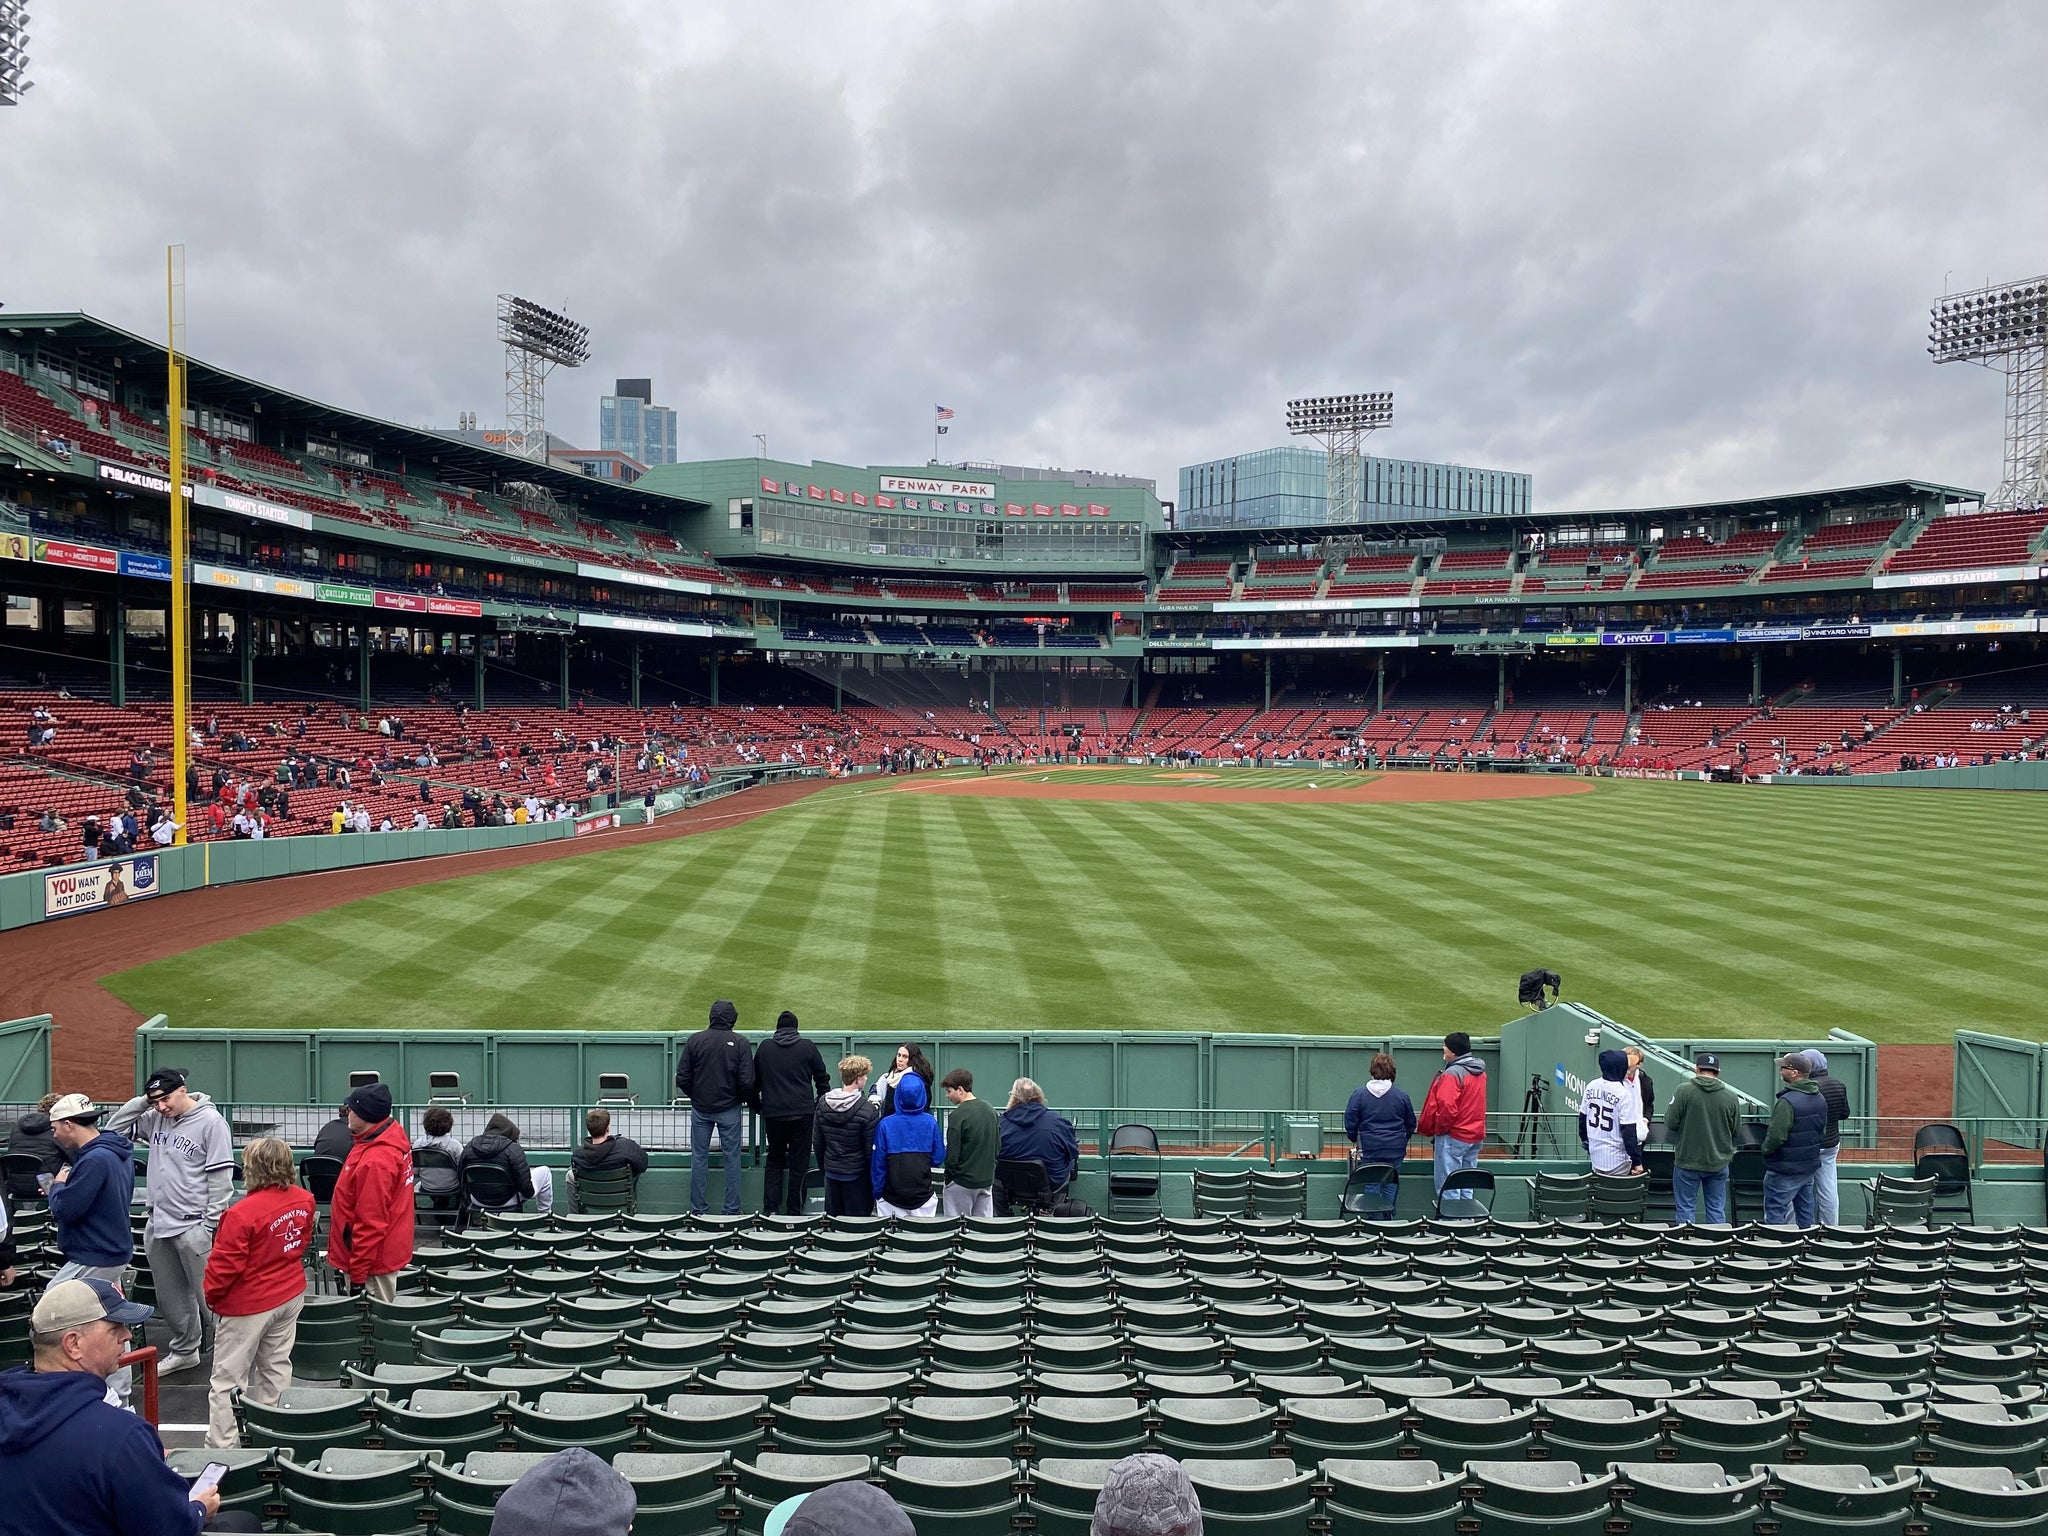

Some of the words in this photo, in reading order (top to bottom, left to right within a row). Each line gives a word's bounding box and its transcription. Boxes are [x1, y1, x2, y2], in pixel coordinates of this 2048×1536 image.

[114, 468, 141, 486] BLACK
[142, 475, 164, 491] LIVES
[164, 481, 193, 498] MTER
[888, 480, 943, 492] FENWAY
[952, 484, 987, 495] PARK
[224, 495, 257, 514] TONIGHT'S
[257, 504, 289, 521] STARTERS
[1909, 574, 1951, 585] TONIGHT'S
[1952, 571, 1998, 583] STARTERS
[325, 589, 348, 599] GRILLO'S
[349, 592, 371, 601] PICKLES
[430, 601, 456, 612] Safelite
[1626, 635, 1653, 643] HYCU
[52, 877, 77, 896] YOU
[78, 875, 100, 889] WANT
[56, 895, 73, 908] HOT
[75, 890, 96, 904] DOGS
[1586, 1089, 1620, 1107] BELLINGER
[1588, 1102, 1614, 1132] 35
[154, 1131, 169, 1146] NEW
[172, 1134, 200, 1157] YORK
[270, 1210, 296, 1232] FENWAY
[283, 1239, 302, 1253] STAFF
